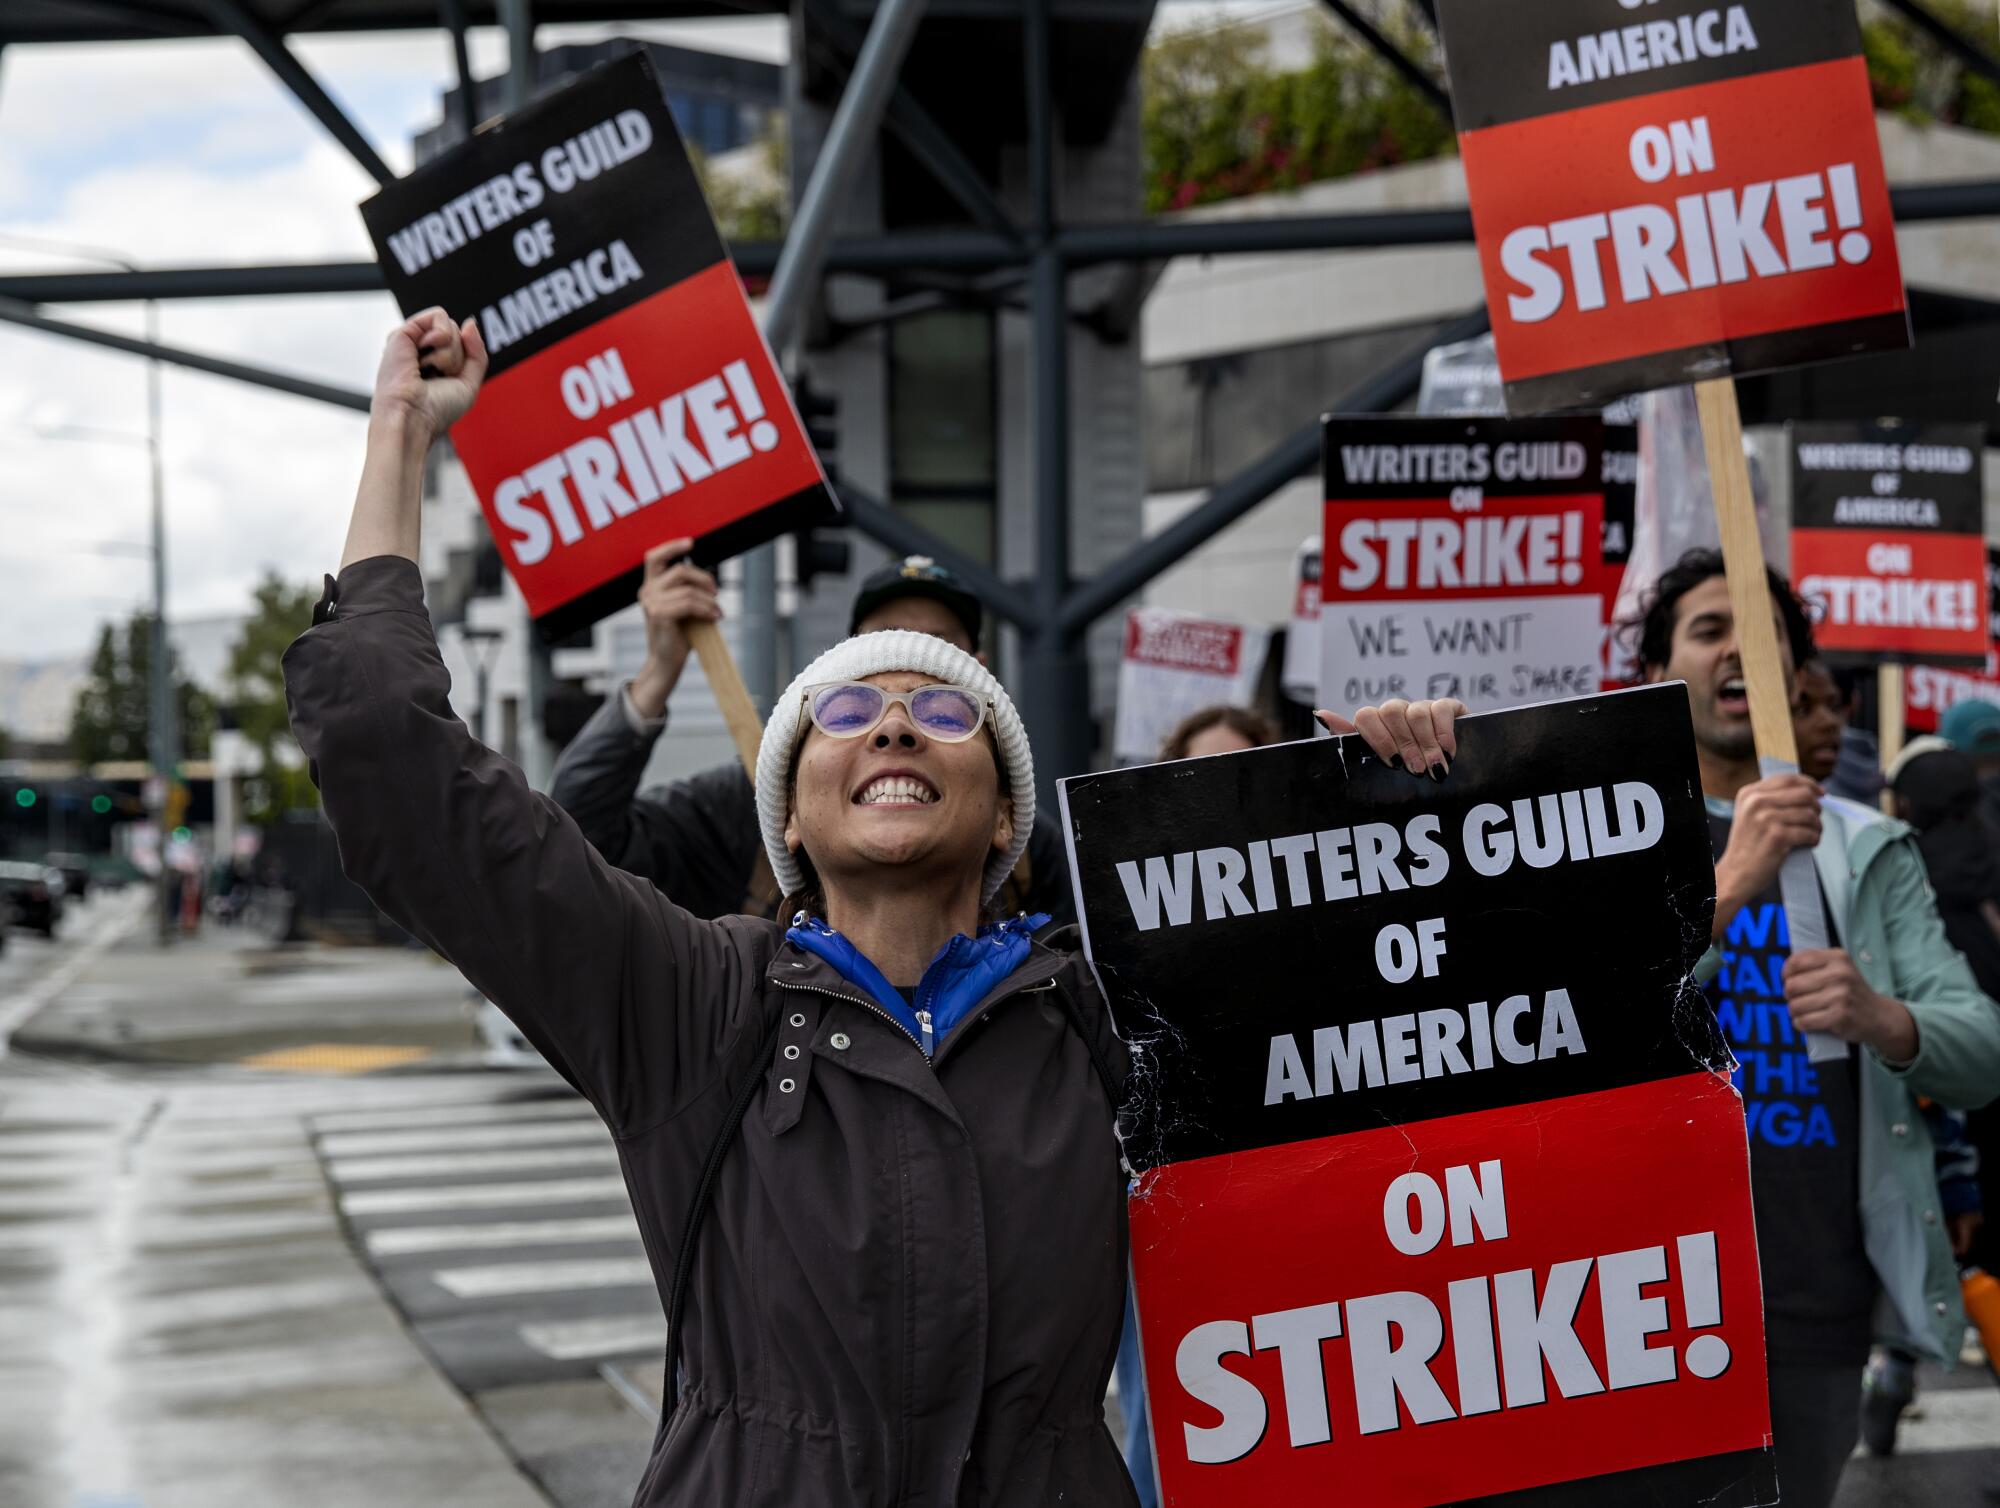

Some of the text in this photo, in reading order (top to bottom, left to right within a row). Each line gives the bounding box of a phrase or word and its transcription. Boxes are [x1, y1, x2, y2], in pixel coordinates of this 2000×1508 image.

[1548, 5, 1758, 89] AMERICA
[1629, 116, 1714, 183] ON
[388, 109, 653, 277] WRITERS GUILD
[512, 219, 556, 266] OF
[1500, 162, 1871, 323] STRIKE!
[482, 239, 644, 354] AMERICA
[560, 348, 634, 420] ON
[493, 359, 780, 565] STRIKE!
[1341, 443, 1490, 483] WRITERS
[1494, 441, 1587, 481] GUILD
[1798, 443, 1973, 474] WRITERS GUILD
[1871, 473, 1901, 496] OF
[1450, 486, 1483, 512] ON
[1833, 497, 1940, 526] AMERICA
[1339, 511, 1584, 591] STRIKE!
[1866, 543, 1912, 575] ON
[1348, 612, 1534, 658] WE WANT
[1800, 575, 1978, 631] STRIKE!
[1345, 664, 1593, 703] OUR FAIR SHARE
[1115, 781, 1665, 932] WRITERS GUILD
[1374, 917, 1447, 984] OF
[1263, 988, 1587, 1107] AMERICA
[1747, 1100, 1837, 1147] GA
[1383, 1159, 1509, 1256] ON
[1174, 1230, 1731, 1465] STRIKE!
